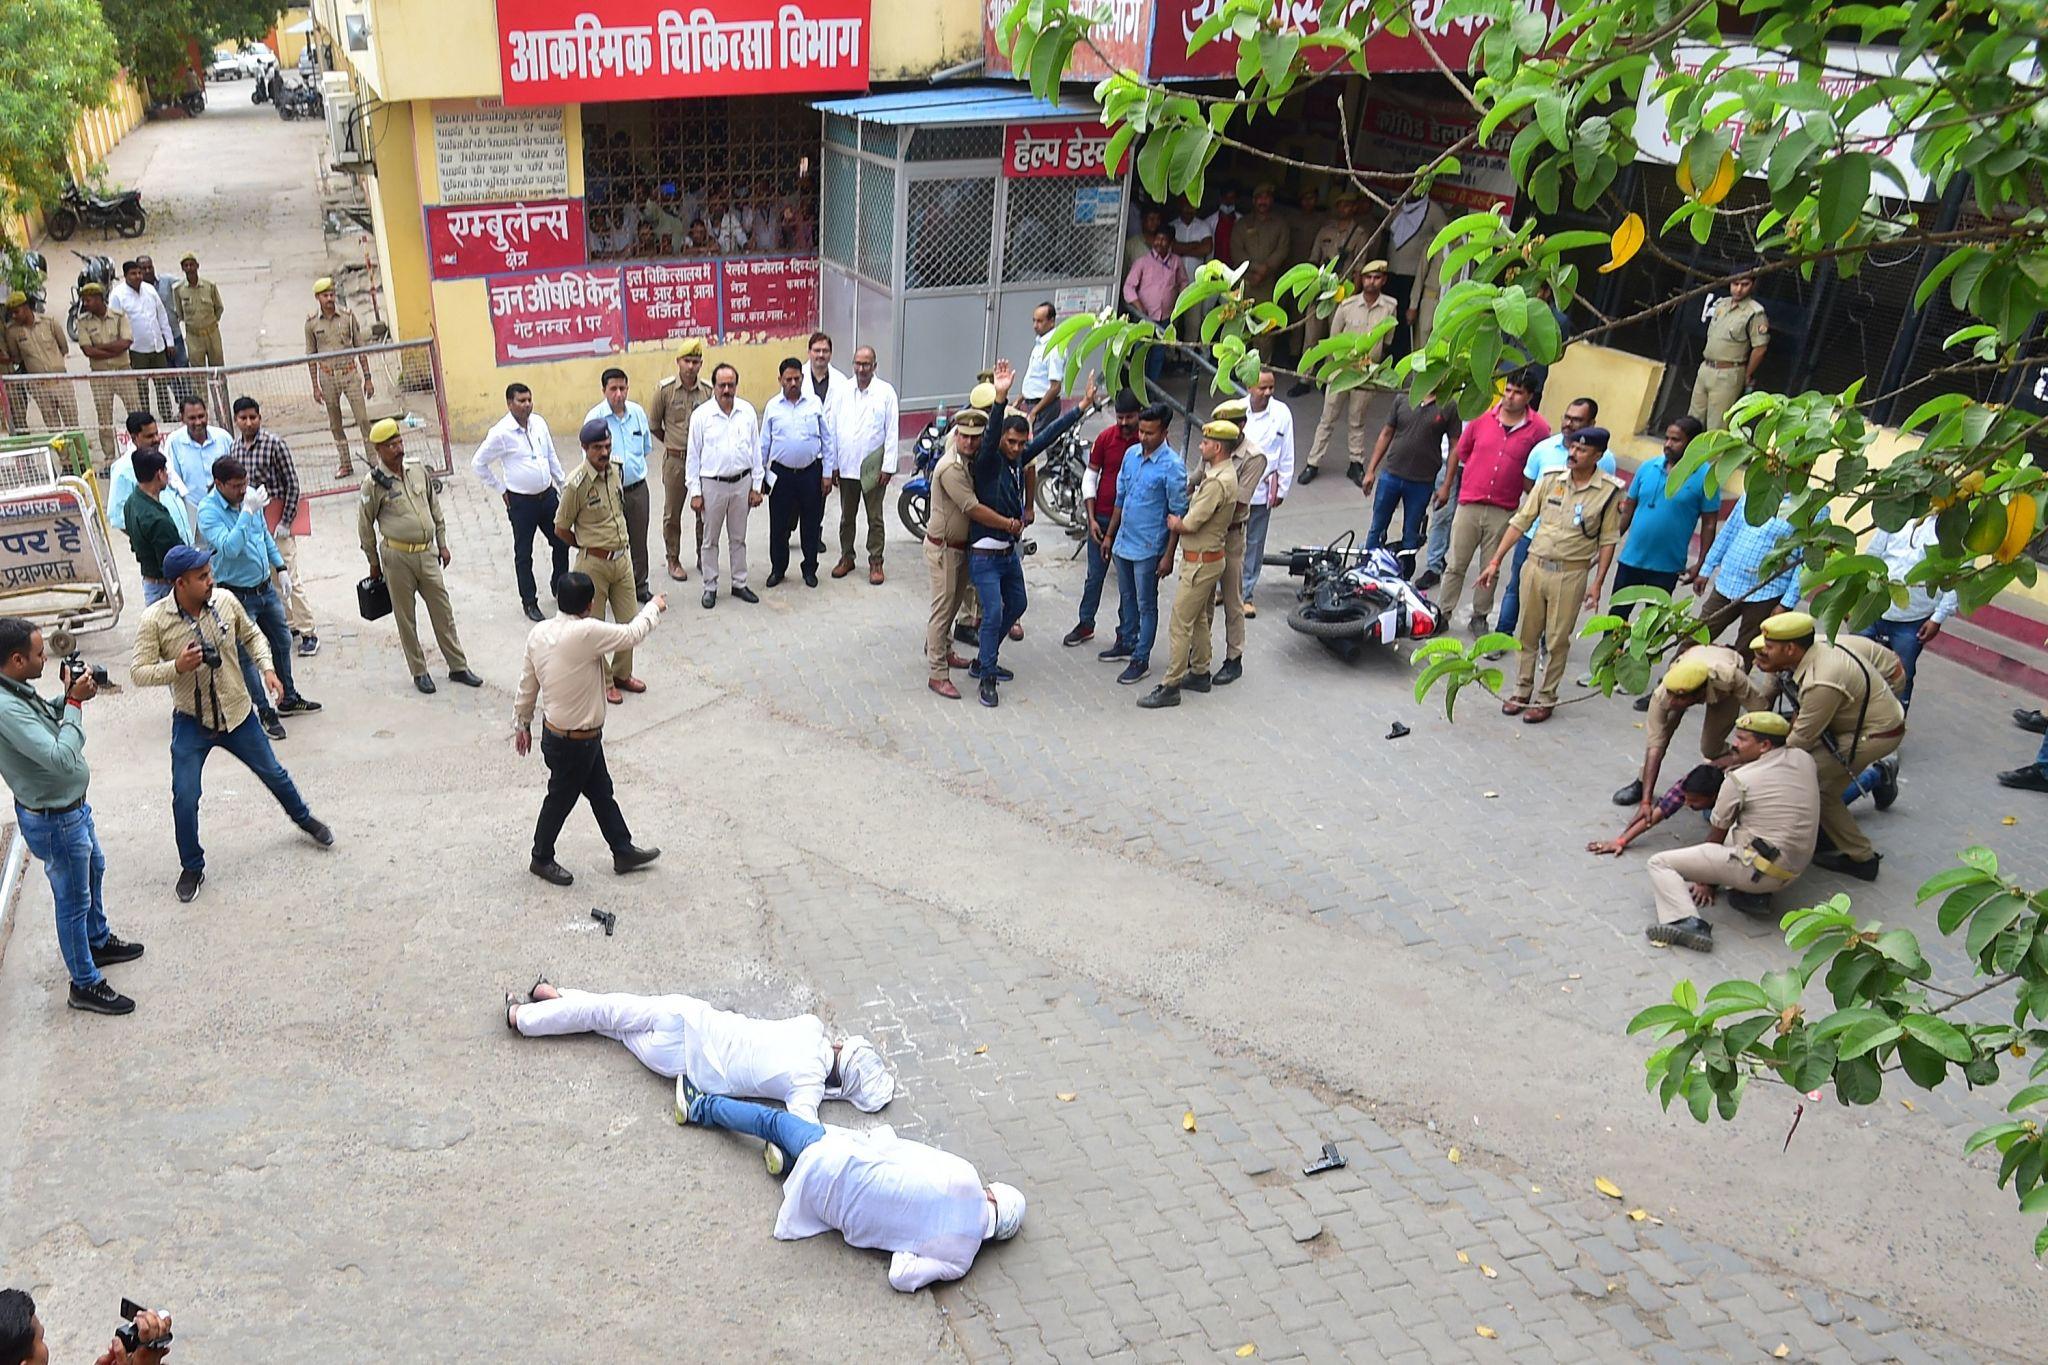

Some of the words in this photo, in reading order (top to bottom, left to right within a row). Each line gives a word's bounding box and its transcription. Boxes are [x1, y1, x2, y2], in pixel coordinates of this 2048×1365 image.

[509, 13, 652, 82] आकस्मिक
[658, 8, 774, 75] चिकित्सा
[779, 4, 863, 69] विभाग
[1013, 128, 1061, 172] हेल्प
[447, 202, 568, 251] एम्बुलेन्स
[505, 248, 528, 270] क्षेत्र
[725, 260, 748, 277] रेलवे
[626, 270, 643, 287] इस
[644, 265, 702, 285] चिकित्सालय
[491, 285, 524, 317] जन
[524, 271, 586, 312] औषधि
[585, 272, 622, 310] केन्द्र
[675, 285, 690, 301] का
[693, 284, 714, 299] आना
[646, 301, 682, 319] वर्जित
[684, 300, 692, 318] है
[514, 319, 533, 339] गेट
[535, 318, 571, 337] नम्बर
[576, 315, 582, 333] 1
[584, 315, 602, 331] पर
[0, 529, 49, 555] पर
[54, 517, 81, 553] है
[2, 560, 76, 588] प्रयागराज
